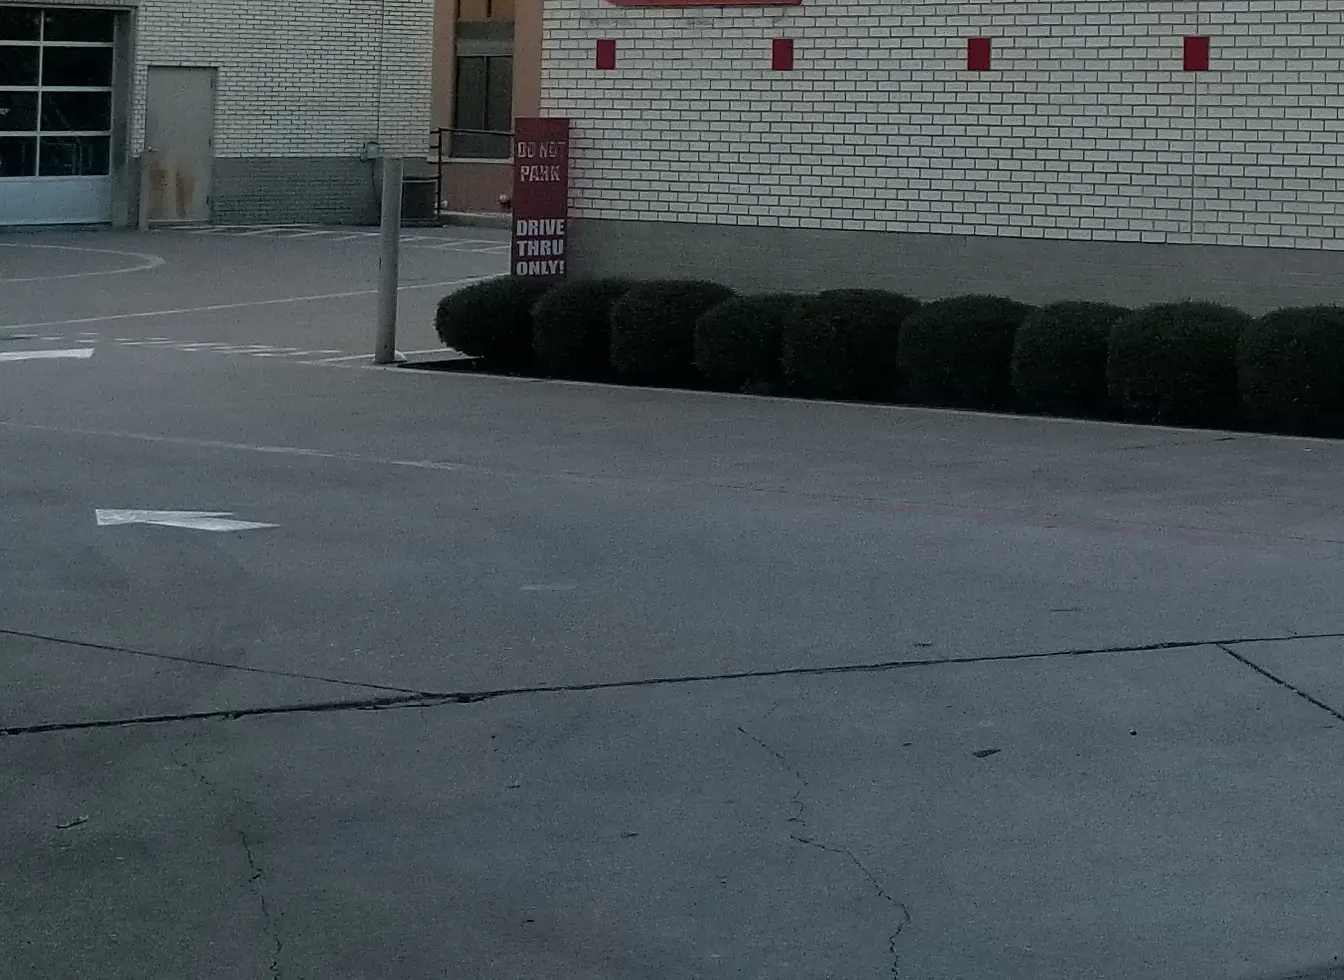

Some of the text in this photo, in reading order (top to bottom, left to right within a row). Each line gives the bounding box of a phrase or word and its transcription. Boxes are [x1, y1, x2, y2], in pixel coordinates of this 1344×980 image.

[516, 219, 565, 236] DRIVE
[516, 239, 564, 256] THRU
[516, 259, 565, 276] ONLY!
